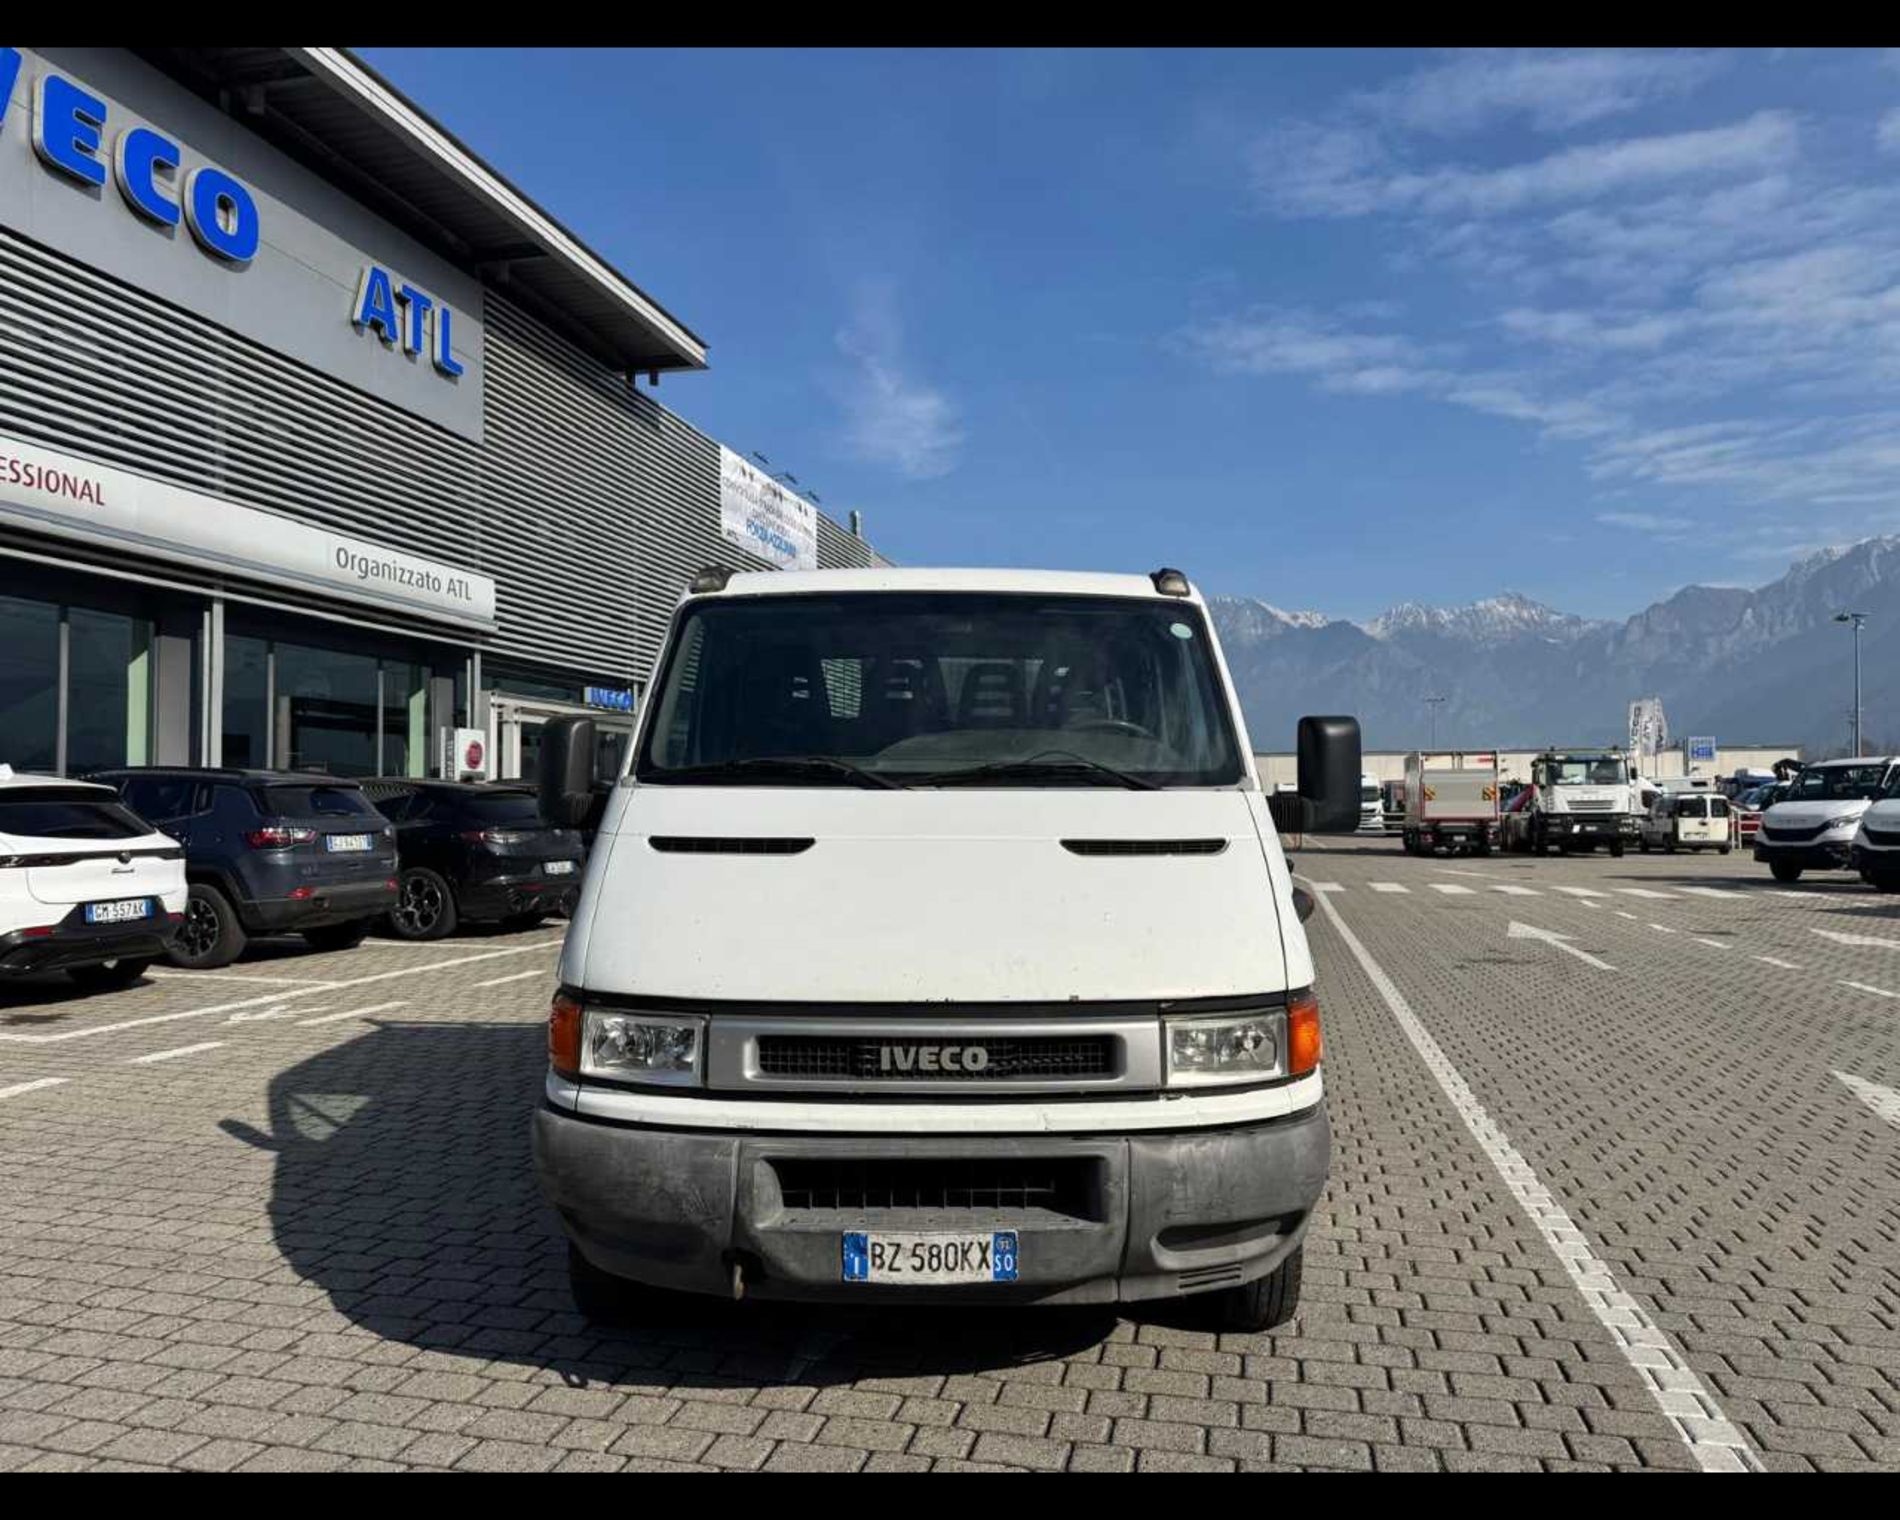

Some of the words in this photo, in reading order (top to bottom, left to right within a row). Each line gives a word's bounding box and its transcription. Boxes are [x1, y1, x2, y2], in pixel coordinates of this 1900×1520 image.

[353, 265, 464, 376] ATL
[336, 547, 442, 593] Organizzato
[446, 577, 473, 601] ATL
[880, 1046, 989, 1071] IVECO
[871, 1243, 902, 1272] BZ
[911, 1242, 991, 1272] 580KX
[995, 1254, 1014, 1272] SO
